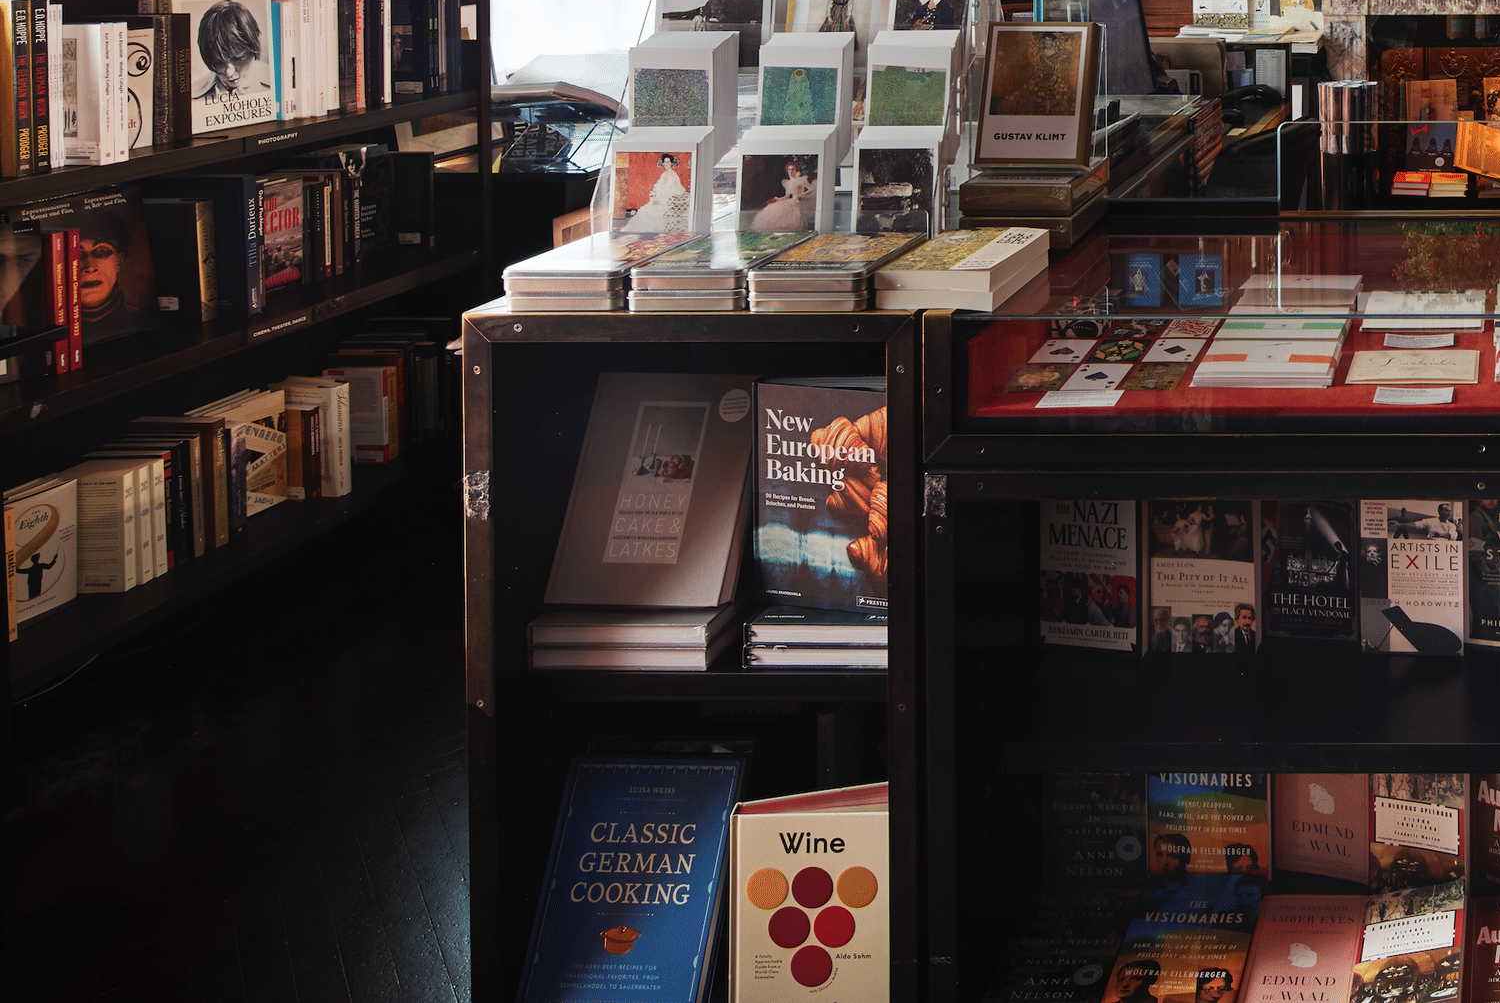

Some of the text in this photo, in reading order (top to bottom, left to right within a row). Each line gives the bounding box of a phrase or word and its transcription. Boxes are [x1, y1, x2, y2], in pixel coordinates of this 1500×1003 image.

[17, 54, 29, 120] THE GERMAN WORK
[35, 52, 46, 117] THE GERMAN WORK
[204, 90, 239, 106] LUCIA
[223, 96, 272, 114] MOHOLY:
[205, 107, 272, 127] EXPOSURES
[19, 128, 30, 160] PRODGER
[38, 125, 48, 157] PRODGER
[257, 131, 299, 145] PHOTOGRAPHY
[993, 132, 1066, 141] GUSTAV KLIMT
[84, 193, 123, 204] Expressionism
[21, 203, 70, 216] Expressionismus
[246, 196, 258, 268] Tilla Durieux
[253, 316, 307, 337] CINEMA, THEATER, DANCE
[765, 407, 813, 433] New
[251, 442, 286, 470] MATTERS
[765, 432, 877, 465] European
[765, 458, 845, 491] Baking
[620, 493, 688, 509] HONEY
[19, 511, 49, 530] Eighth
[1056, 501, 1119, 525] THE NAZI
[614, 517, 682, 533] CAKE &
[1049, 524, 1128, 550] MENACE
[608, 542, 677, 558] LATKES
[1390, 542, 1459, 553] ARTISTS IN
[1390, 554, 1459, 571] EXILE
[1271, 593, 1351, 610] THE HOTEL
[1406, 600, 1459, 608] HOROWITZ
[1049, 625, 1129, 640] BENJAMIN CARTER HETT
[1159, 773, 1253, 787] VISIONARIES
[590, 822, 697, 845] CLASSIC
[1292, 820, 1354, 840] EDMUND
[779, 832, 846, 854] Wine
[1160, 844, 1251, 856] WOLFRAM EILENBERGER
[579, 851, 696, 875] GERMAN
[1073, 850, 1116, 860] ANNE
[1066, 866, 1124, 876] NELSON
[570, 881, 691, 906] COOKING
[1145, 912, 1245, 924] VISIONARIES
[1125, 969, 1227, 979] WOLFRAM EILENBERGER
[1262, 975, 1337, 987] EDMUND
[1488, 975, 1500, 983] and
